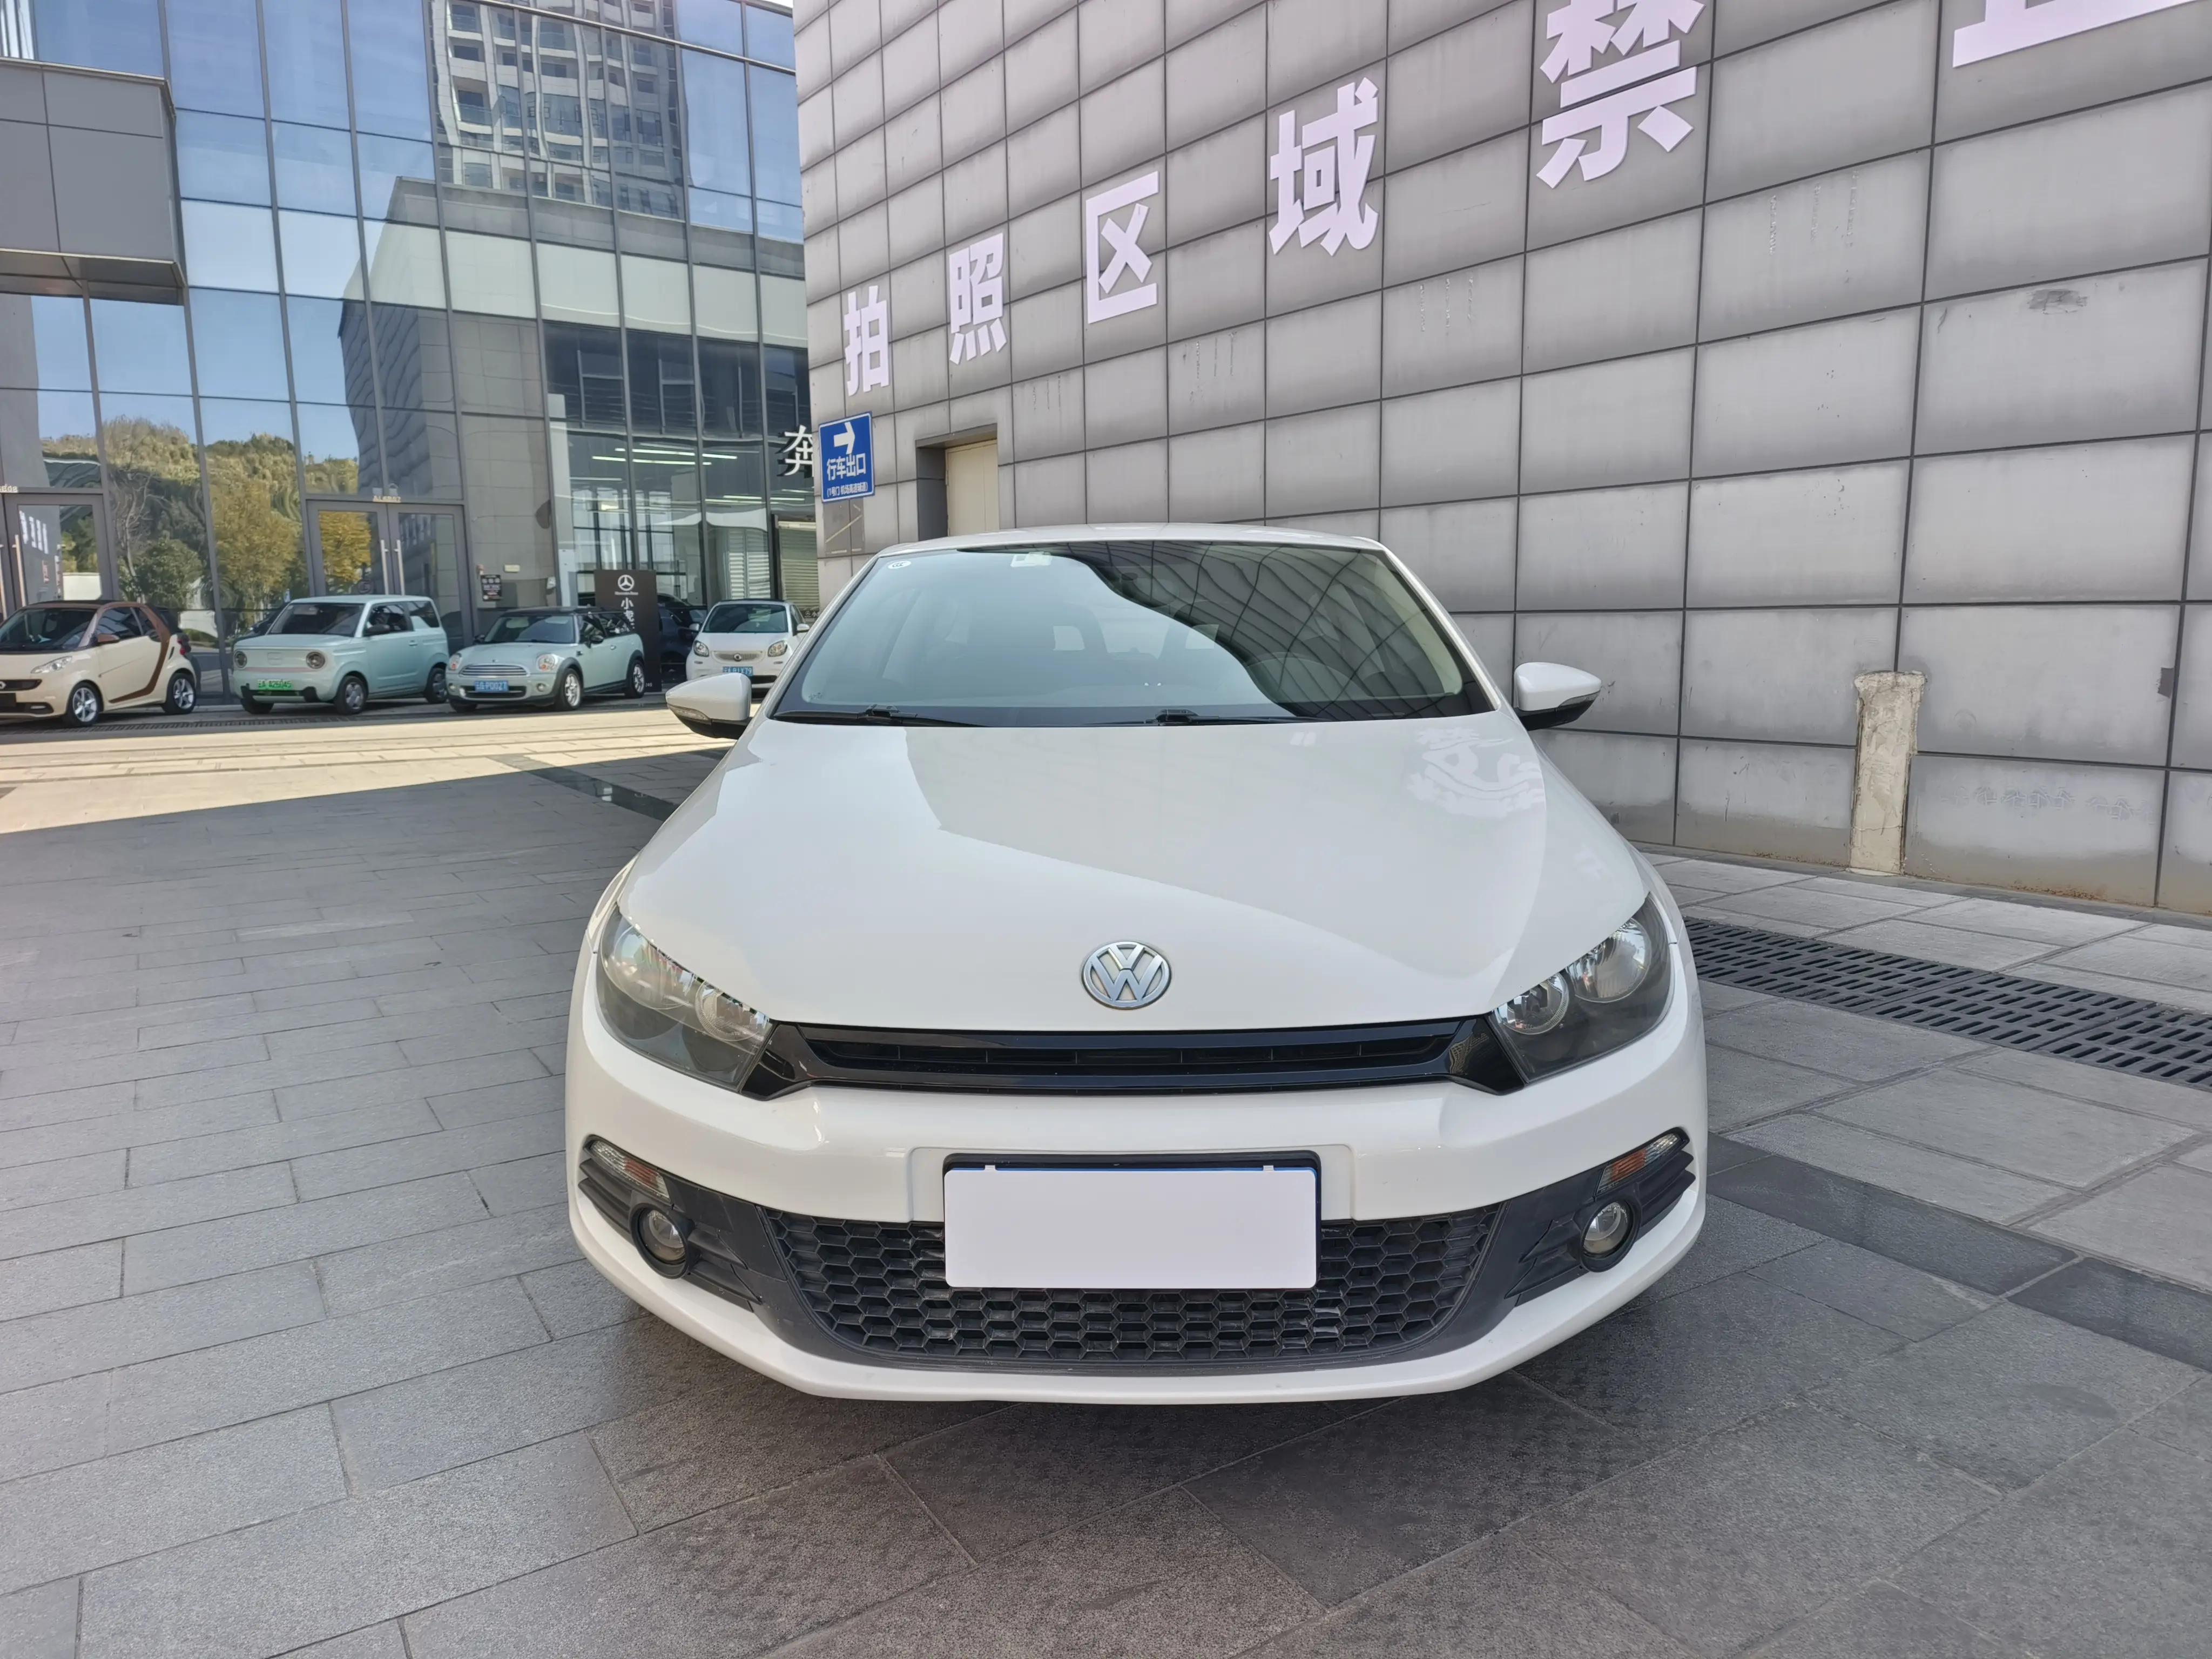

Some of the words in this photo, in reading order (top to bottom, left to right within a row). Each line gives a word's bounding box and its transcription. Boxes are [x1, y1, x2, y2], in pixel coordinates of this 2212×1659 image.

[783, 424, 813, 477] 奔
[826, 453, 866, 481] 行车出口
[1083, 942, 1170, 1008] VW
